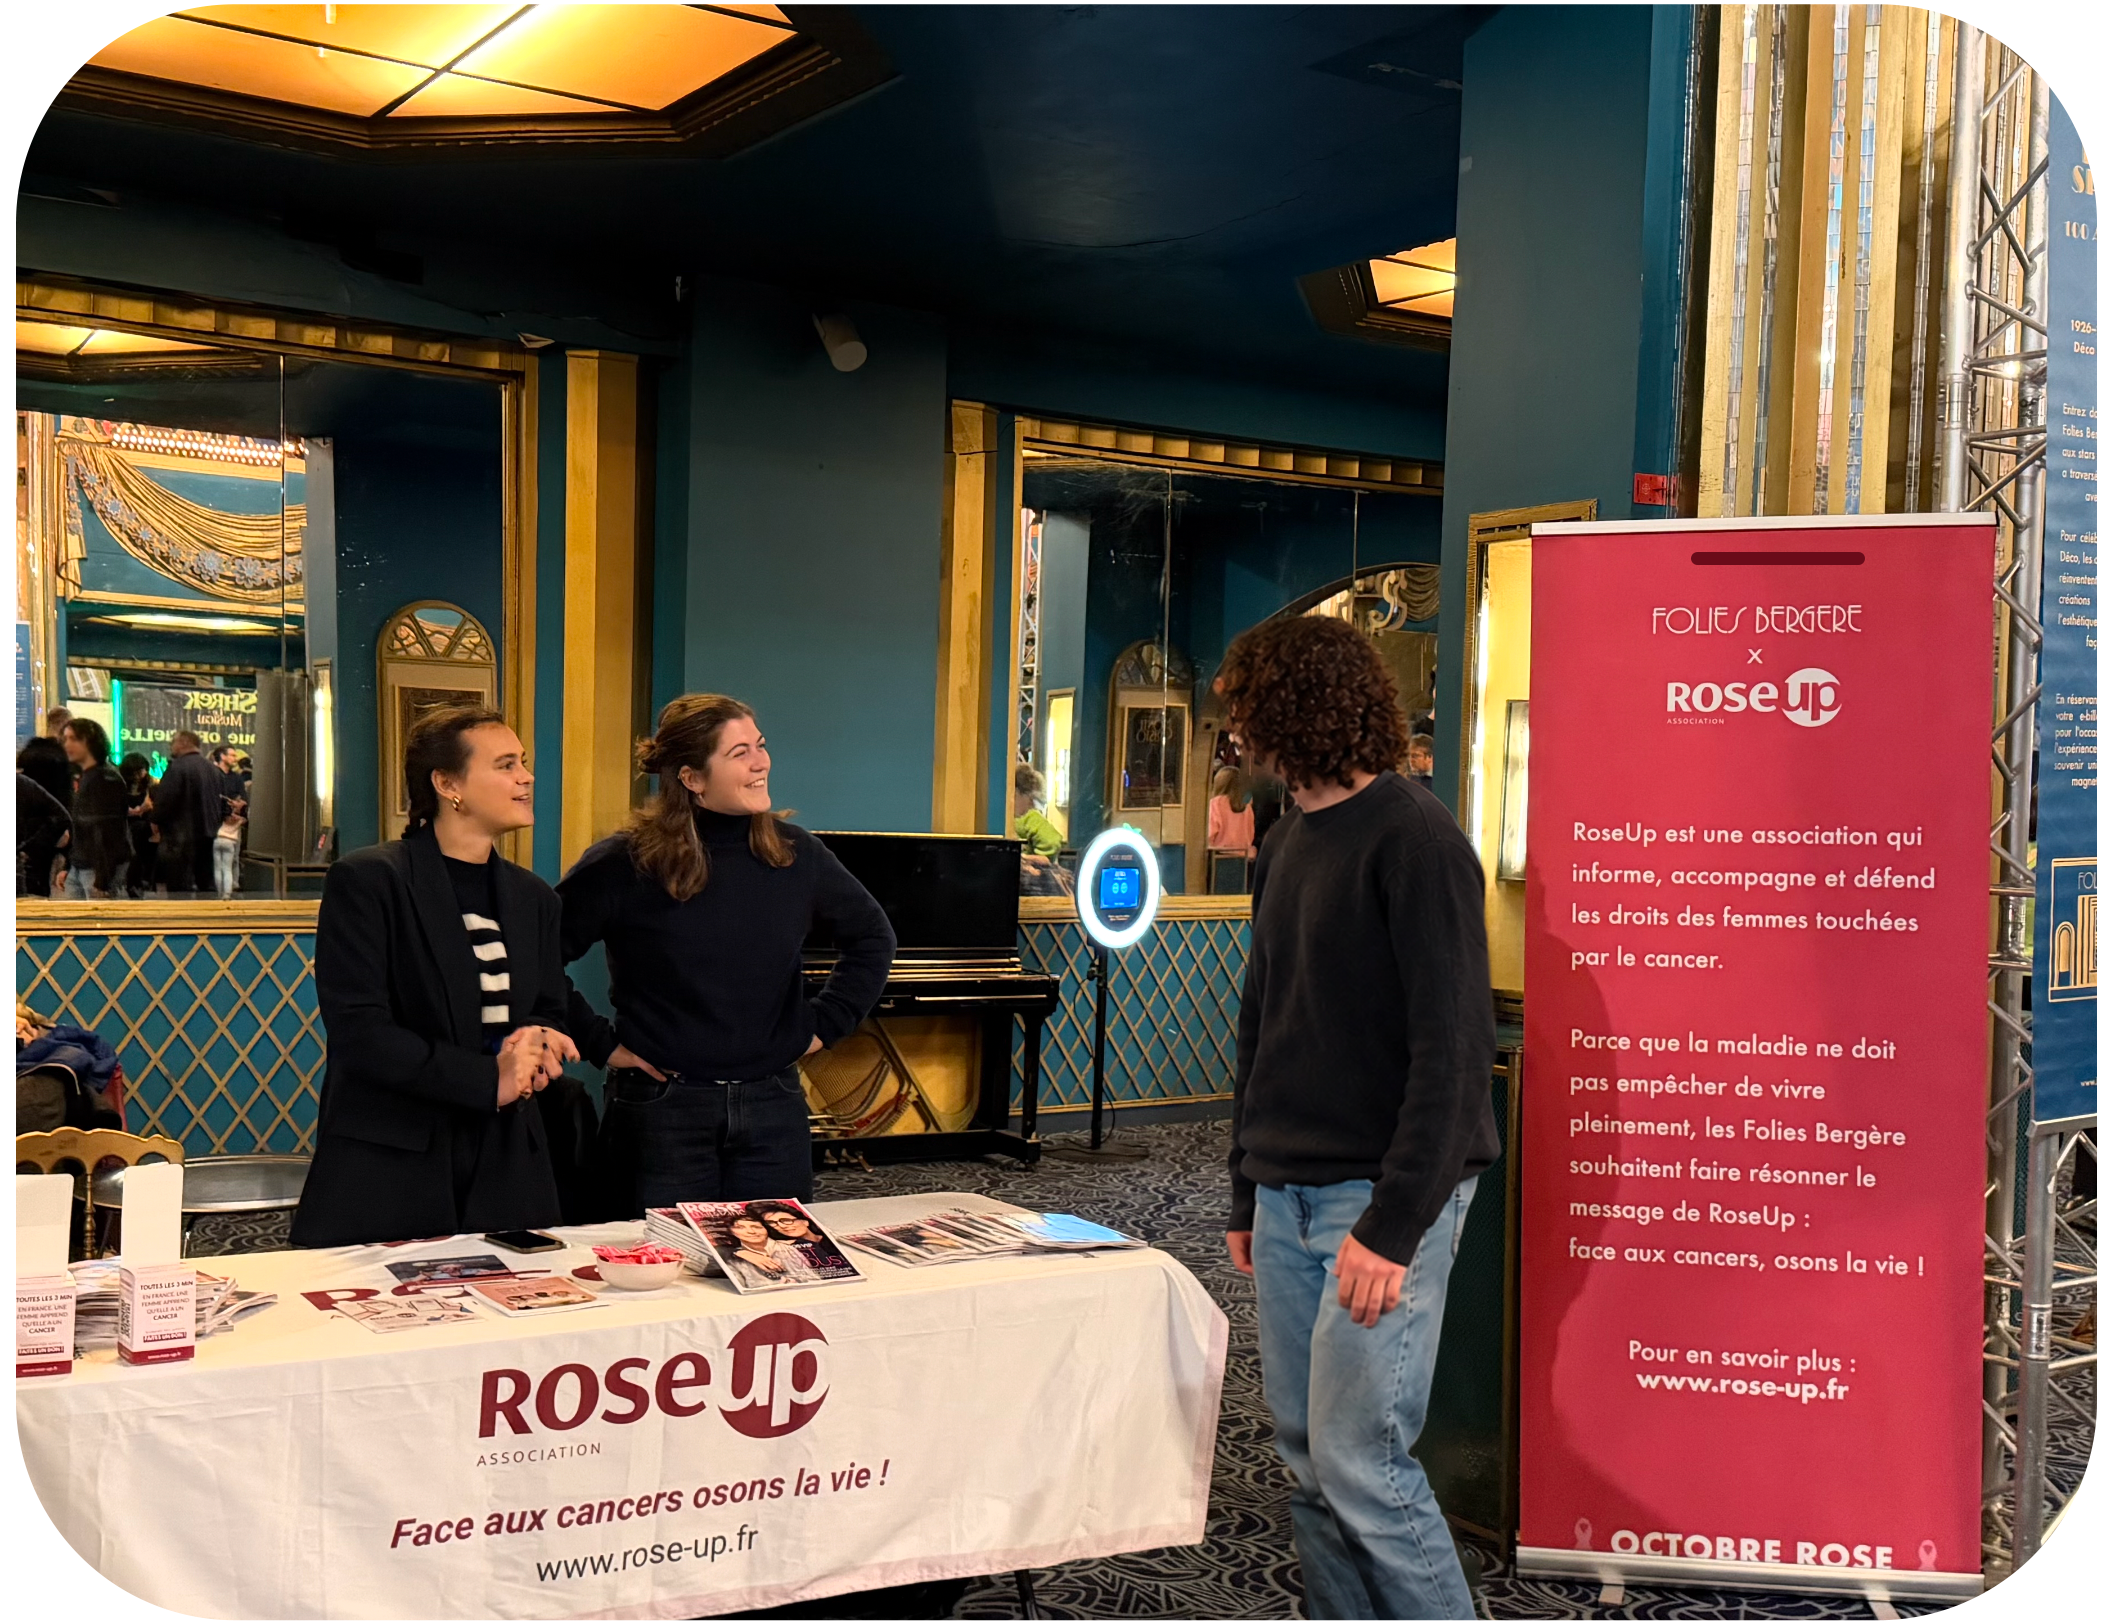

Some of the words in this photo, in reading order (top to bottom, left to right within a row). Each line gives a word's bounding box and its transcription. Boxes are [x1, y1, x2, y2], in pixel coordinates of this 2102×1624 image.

[2064, 221, 2089, 240] 100
[2063, 403, 2086, 417] Entrez
[2063, 424, 2083, 438] Folies
[2062, 449, 2075, 457] aux
[2078, 449, 2095, 459] stars
[2061, 530, 2076, 542] Pour
[2060, 551, 2080, 564] Déco,
[2083, 552, 2092, 564] les
[2059, 594, 2090, 605] créations
[1653, 607, 1746, 634] FOLIES
[1756, 605, 1861, 633] BERGERE
[2056, 693, 2064, 704] En
[2056, 711, 2073, 720] votre
[2055, 729, 2072, 740] pour
[2054, 759, 2084, 770] souvenir
[1574, 822, 1656, 847] RoseUp
[1666, 826, 1695, 842] est
[1704, 830, 1743, 843] une
[1752, 826, 1877, 844] association
[1887, 827, 1921, 851] qui
[1573, 862, 1661, 887] informe,
[1671, 871, 1816, 891] accompagne
[1825, 870, 1846, 886] et
[1854, 867, 1934, 888] défend
[1573, 903, 1600, 923] les
[1609, 904, 1668, 925] droits
[1677, 905, 1714, 926] des
[1723, 906, 1807, 928] femmes
[1816, 909, 1918, 931] touchées
[1572, 952, 1609, 970] par
[1618, 946, 1635, 966] le
[1645, 954, 1722, 968] cancer.
[1572, 1029, 1630, 1049] Parce
[1640, 1038, 1679, 1056] que
[1689, 1031, 1708, 1052] la
[1718, 1034, 1807, 1056] maladie
[1817, 1044, 1842, 1057] ne
[1852, 1037, 1896, 1059] doit
[1571, 1077, 1608, 1095] pas
[1617, 1074, 1727, 1098] empêcher
[1735, 1076, 1762, 1096] de
[1771, 1079, 1825, 1099] vivre
[1571, 1112, 1695, 1140] pleinement,
[1706, 1117, 1735, 1138] les
[1745, 1119, 1806, 1141] Folies
[1816, 1123, 1905, 1149] Bergère
[1571, 1155, 1682, 1178] souhaitent
[1690, 1158, 1740, 1181] faire
[1750, 1163, 1848, 1185] résonner
[1857, 1166, 1875, 1187] le
[1571, 1203, 1663, 1225] message
[1673, 1200, 1700, 1221] de
[1710, 1203, 1795, 1232] RoseUp
[1805, 1214, 1809, 1227] :
[1570, 1238, 1615, 1260] face
[1625, 1248, 1665, 1262] aux
[1674, 1251, 1764, 1271] cancers,
[1775, 1256, 1838, 1271] osons
[1847, 1251, 1866, 1272] la
[1876, 1255, 1908, 1275] vie
[1919, 1257, 1923, 1276] !
[1630, 1340, 1678, 1361] Pour
[1687, 1350, 1712, 1364] en
[1722, 1349, 1789, 1368] savoir
[1798, 1349, 1841, 1375] plus
[1851, 1359, 1855, 1372] :
[1636, 1374, 1849, 1404] www.rose-up.fr
[477, 1443, 600, 1466] ASSOCIATION
[391, 1518, 474, 1548] Face
[484, 1509, 548, 1535] aux
[557, 1491, 683, 1528] cancers
[693, 1478, 785, 1508] osons
[794, 1468, 820, 1496] la
[831, 1462, 871, 1492] vie
[880, 1459, 890, 1486] !
[536, 1524, 758, 1582] www.rose-up.fr
[1611, 1529, 1781, 1563] OCTOBRE
[1797, 1542, 1892, 1570] ROSE
